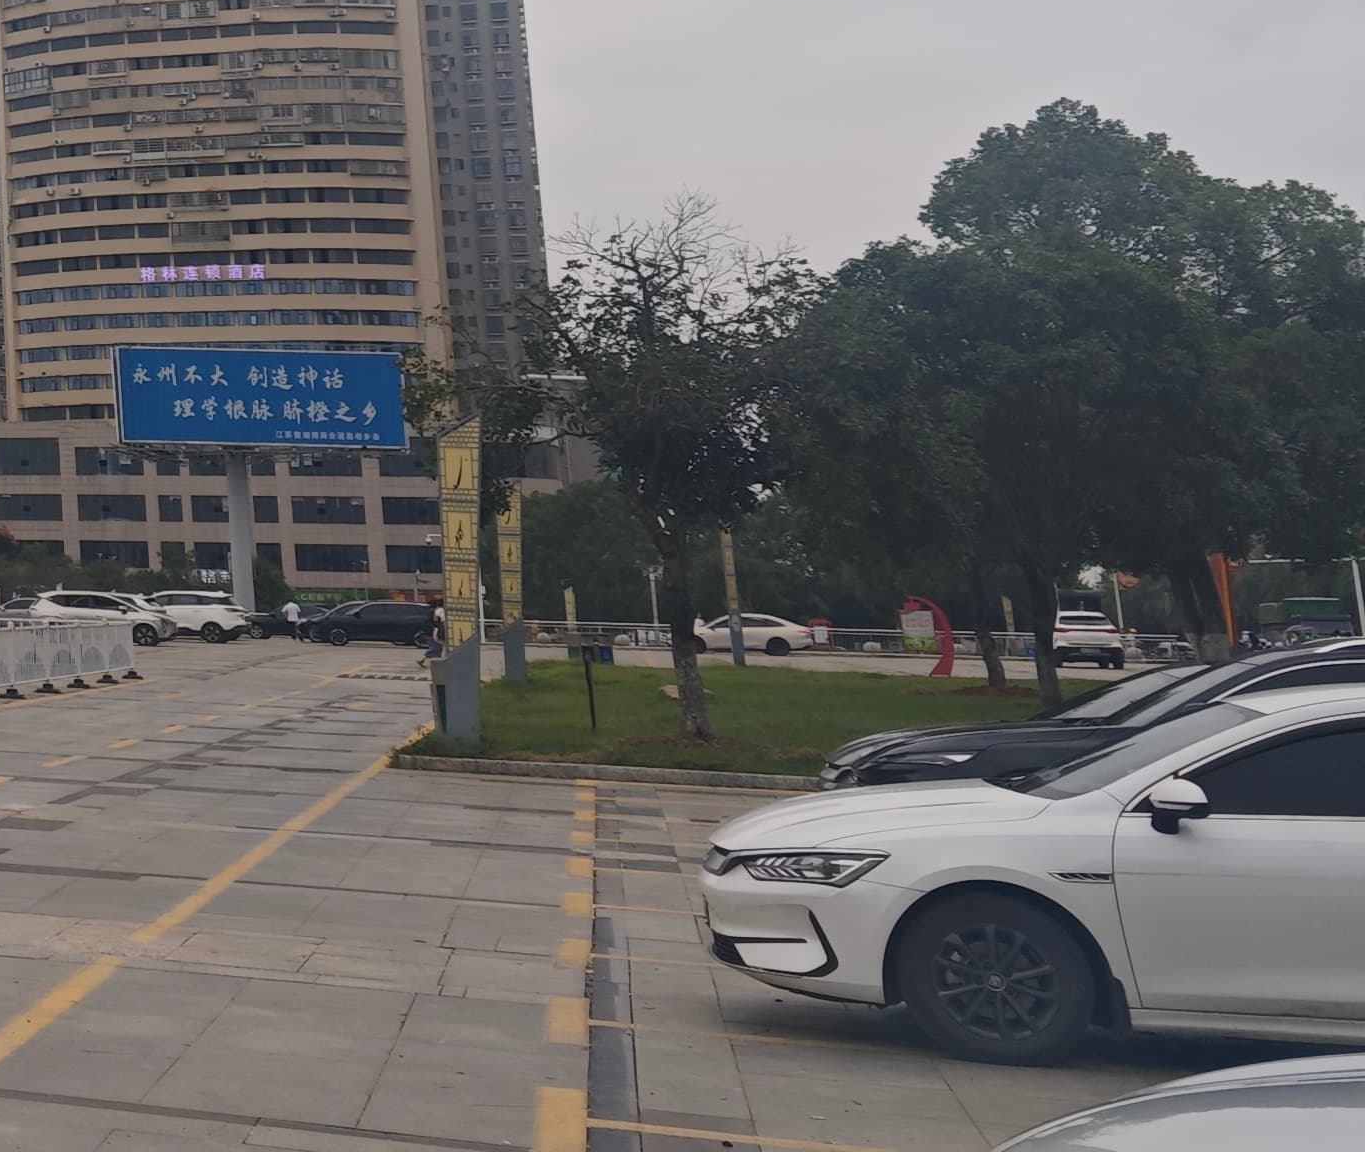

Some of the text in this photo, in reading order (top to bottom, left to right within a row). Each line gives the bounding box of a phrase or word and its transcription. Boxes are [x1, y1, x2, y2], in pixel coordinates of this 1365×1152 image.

[132, 363, 345, 390] 永州不大 创造神话
[173, 397, 378, 426] 理学根脉 脐橙之乡
